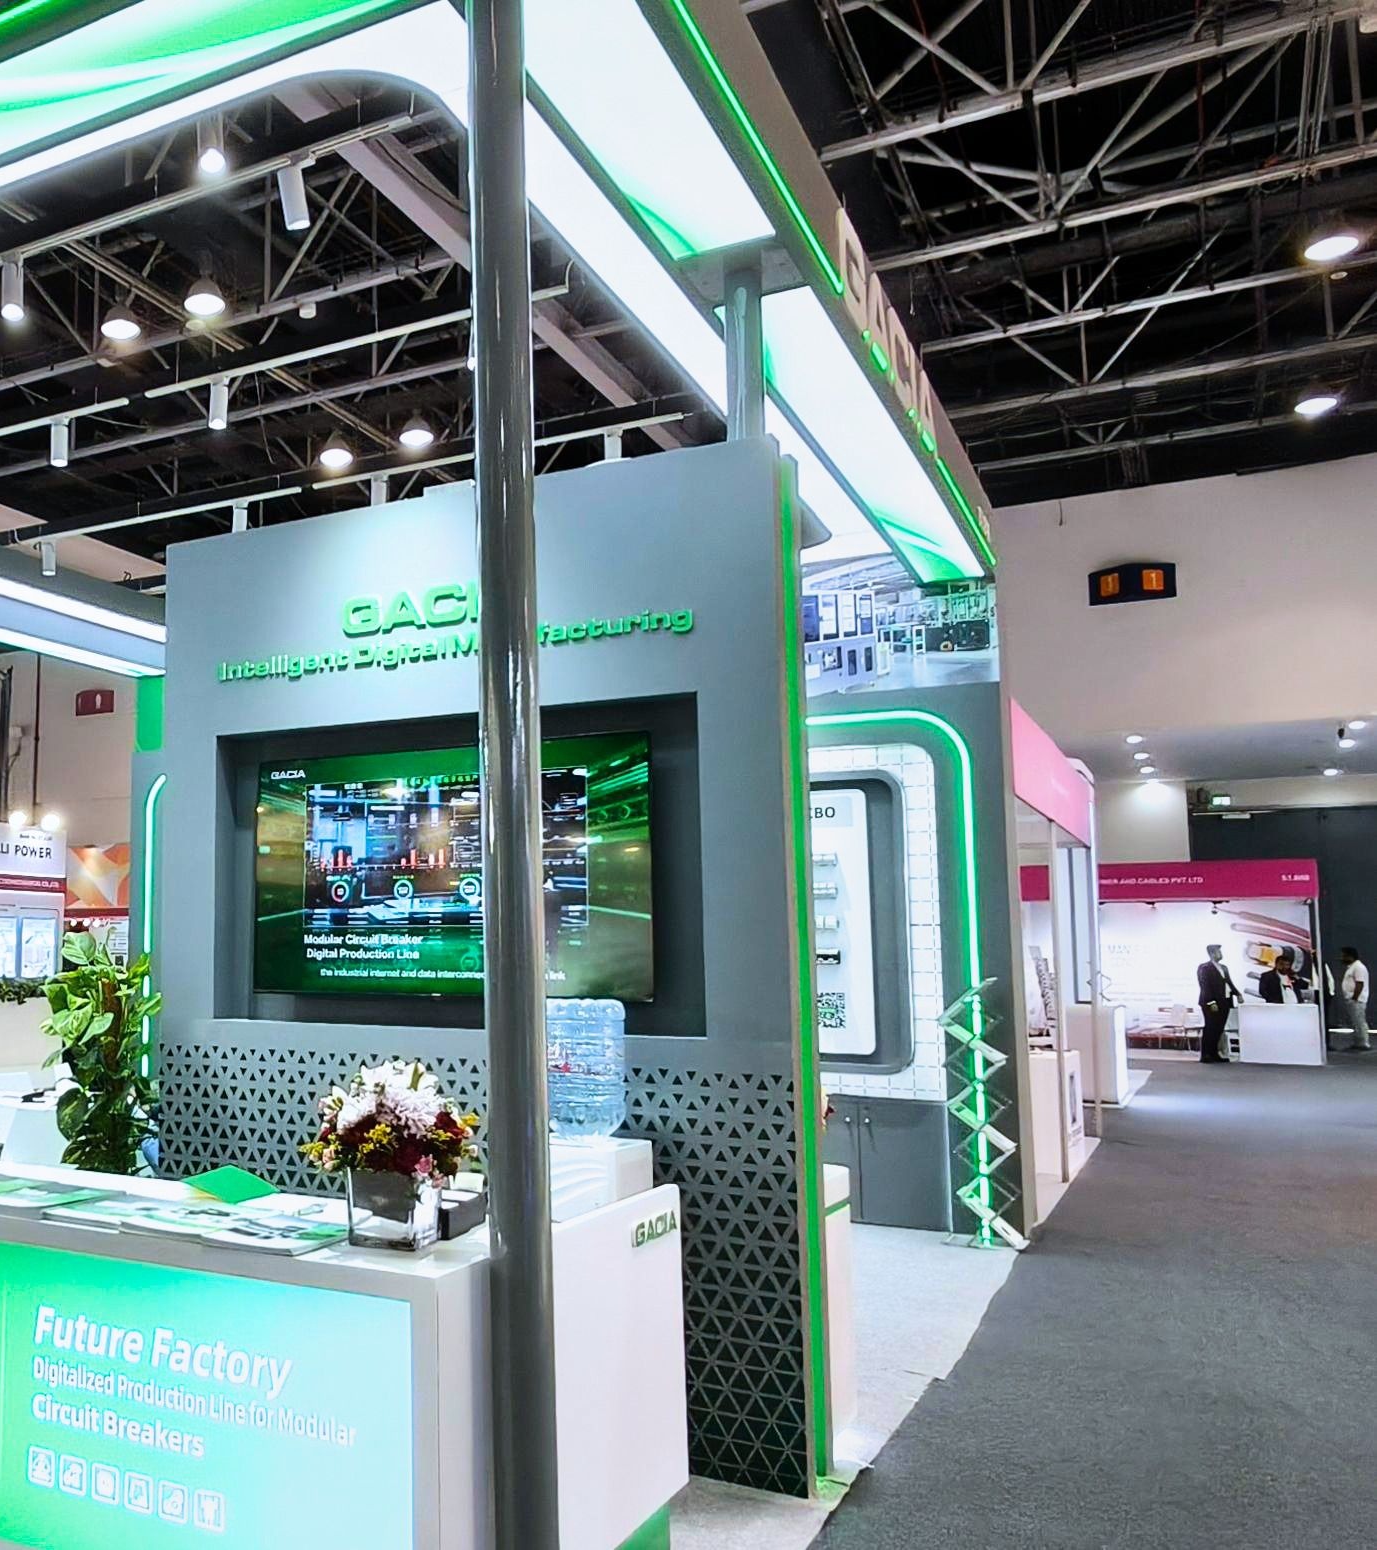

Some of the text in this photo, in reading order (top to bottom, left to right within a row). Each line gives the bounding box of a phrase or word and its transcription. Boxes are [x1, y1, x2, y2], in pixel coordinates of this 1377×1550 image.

[341, 581, 479, 637] GACI
[217, 608, 694, 682] Intelligent Digital Mfacturing
[271, 769, 306, 779] GACIA
[14, 844, 52, 859] POWER
[1188, 876, 1204, 884] LTD
[304, 933, 423, 945] Modular Circuit Breaker
[306, 947, 419, 960] Digital Production Line
[320, 968, 333, 977] the
[401, 969, 417, 978] and
[418, 969, 436, 978] data
[437, 969, 485, 979] interconnec
[631, 1210, 677, 1249] GACIA
[34, 1304, 293, 1400] Future Factory
[33, 1356, 357, 1448] Digitalized Production Line for Modular
[32, 1394, 206, 1459] Circuit Breakers
